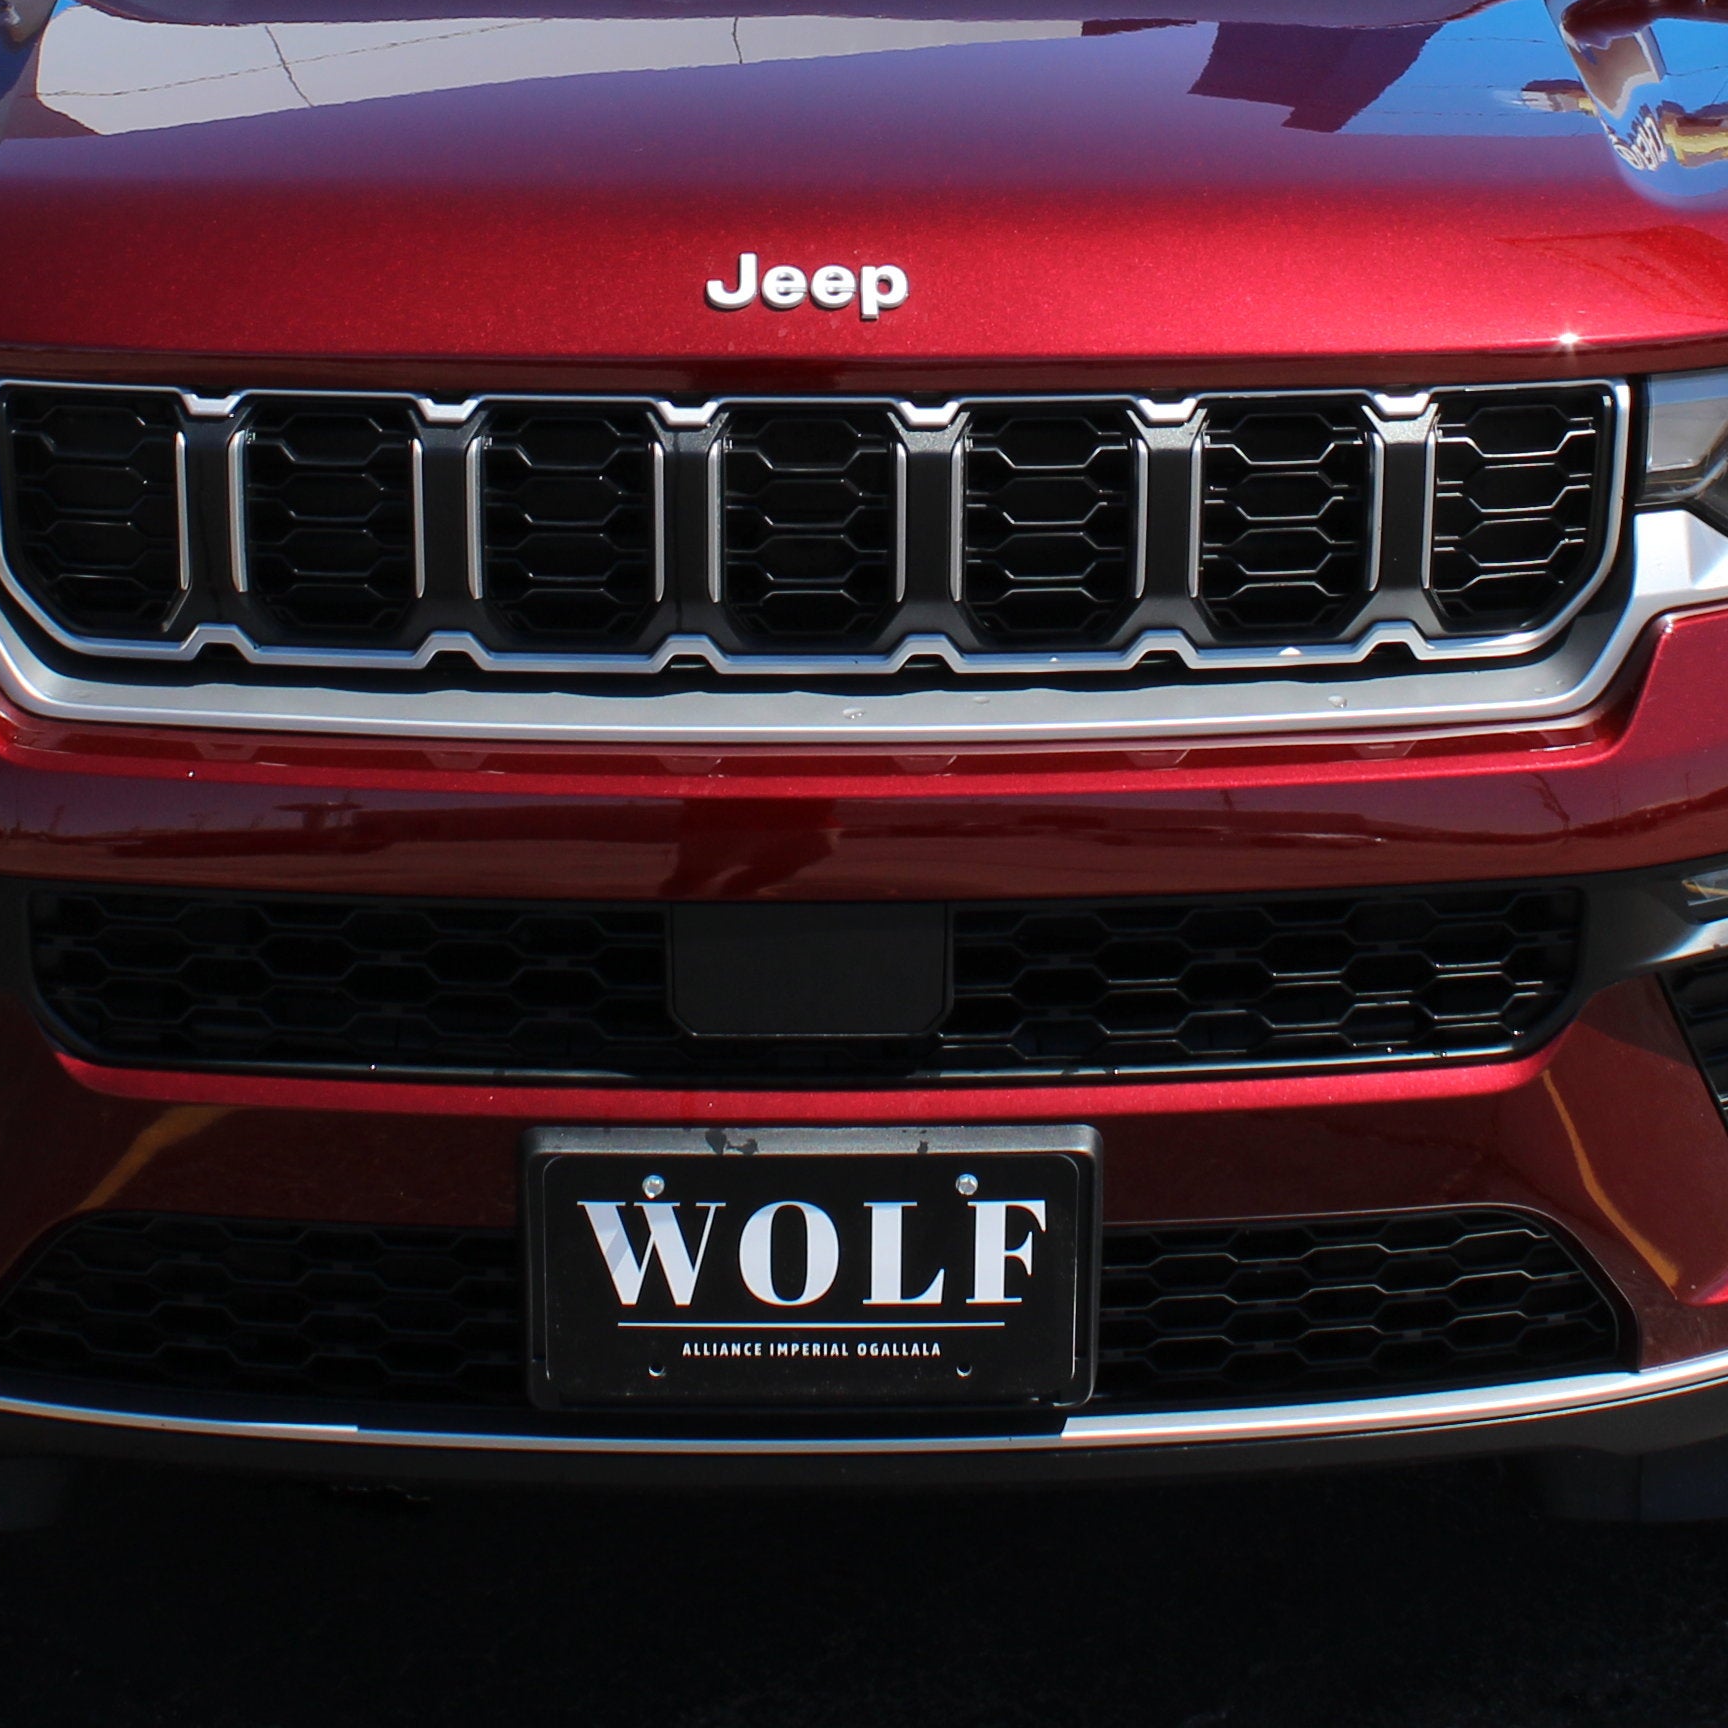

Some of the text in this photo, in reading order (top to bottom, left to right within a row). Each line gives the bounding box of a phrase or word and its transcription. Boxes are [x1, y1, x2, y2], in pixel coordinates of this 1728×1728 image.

[705, 252, 910, 321] Jeep
[576, 1200, 1048, 1307] WOLF
[682, 1342, 942, 1357] ALLIANCE IMPERIAL OGALLALA
